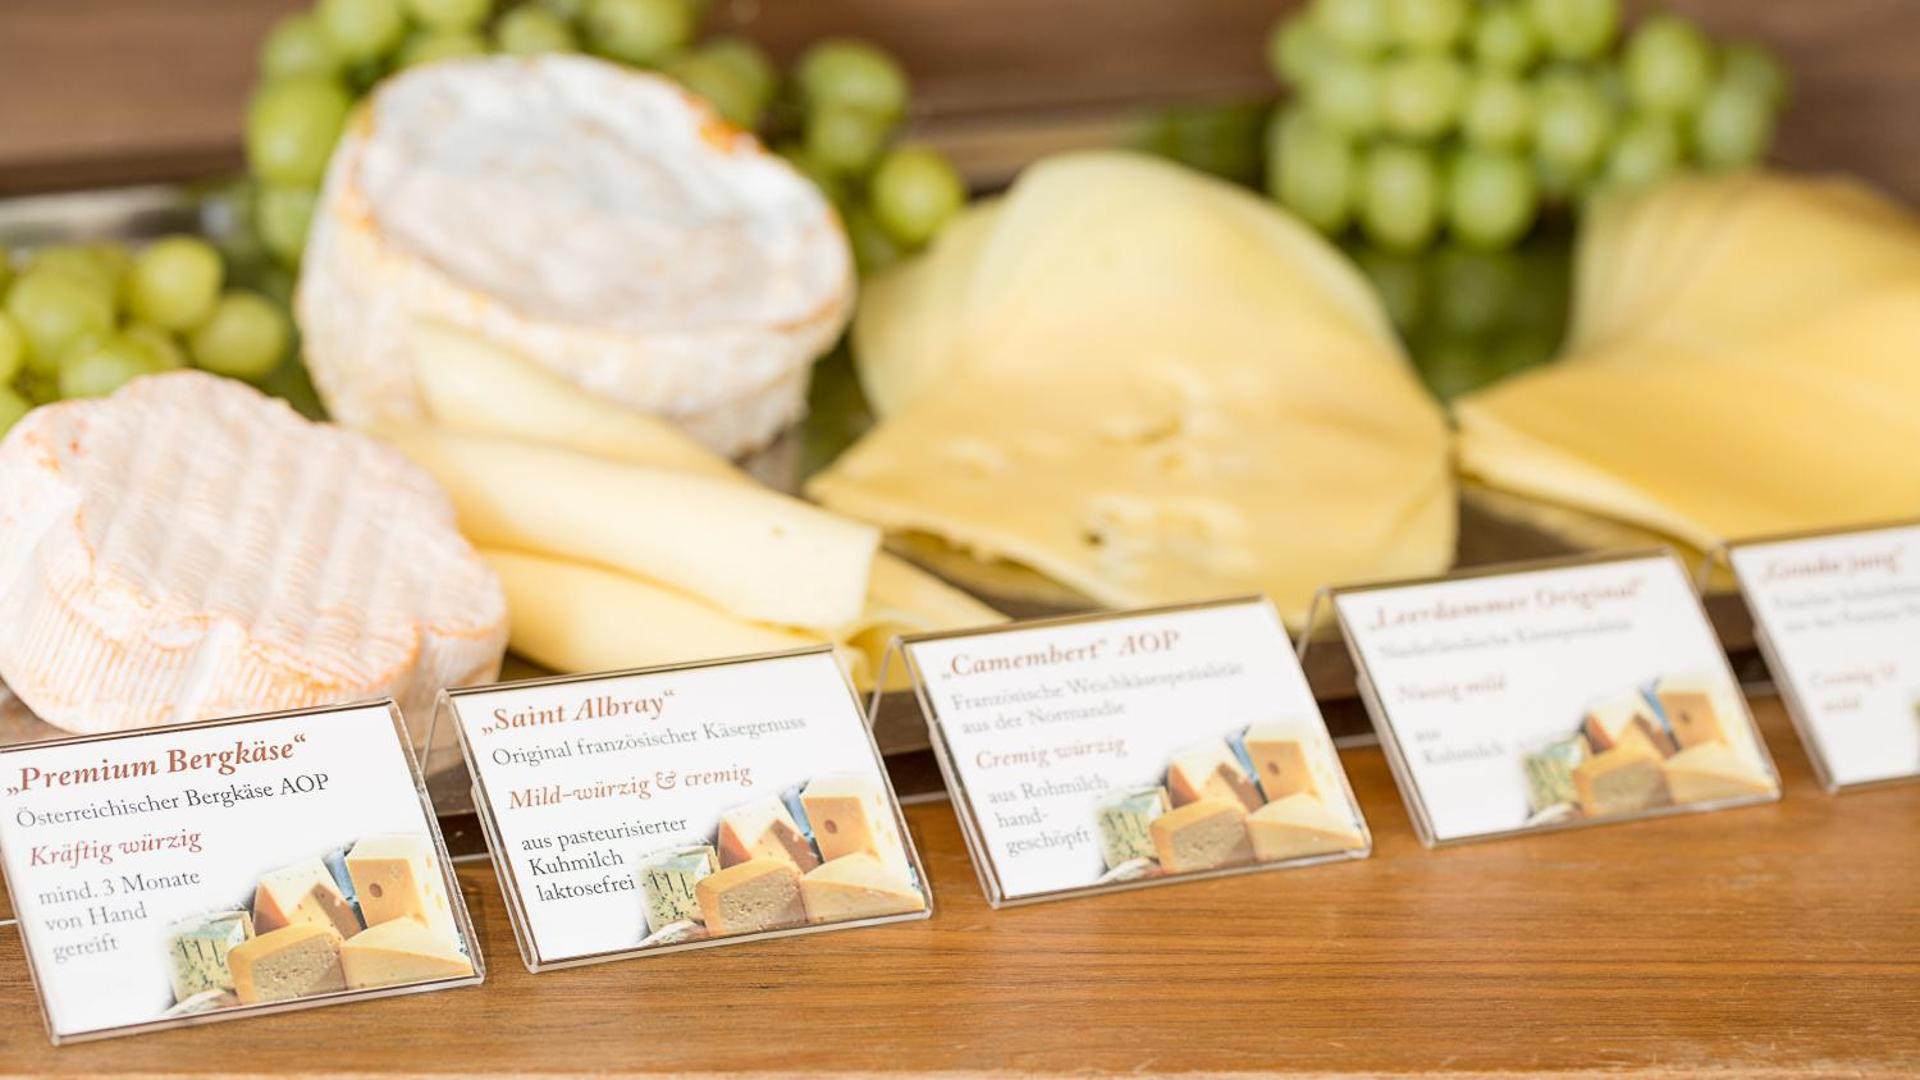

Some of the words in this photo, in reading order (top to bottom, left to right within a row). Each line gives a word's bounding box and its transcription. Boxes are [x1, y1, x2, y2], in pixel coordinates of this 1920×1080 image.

[942, 639, 1108, 680] „Camembert“
[1117, 630, 1180, 657] AOP
[481, 703, 566, 736] „Saint
[574, 689, 675, 721] Albray“
[950, 685, 1064, 711] Französische
[962, 720, 990, 735] aus
[995, 708, 1023, 731] der
[1027, 700, 1126, 726] Normandie
[491, 742, 573, 768] Original
[576, 725, 698, 756] französischer
[703, 716, 808, 743] Käsegenuss
[975, 743, 1051, 768] Cremig
[1053, 738, 1130, 759] würzig
[5, 757, 160, 797] „Premium
[167, 733, 307, 776] Bergkäse“
[16, 794, 181, 828] Österreichischer
[185, 783, 275, 808] Bergkäse
[279, 772, 330, 797] AOP
[508, 775, 653, 811] Mild-würzig
[655, 770, 678, 790] &
[684, 765, 754, 788] cremig
[988, 789, 1018, 804] aus
[1020, 773, 1110, 799] Rohmilch
[521, 835, 553, 852] aus
[556, 817, 688, 851] pasteurisierter
[995, 807, 1049, 829] hand-
[29, 839, 114, 869] Kräftig
[118, 828, 203, 853] würzig
[1005, 825, 1091, 858] geschöpft
[528, 849, 625, 877] Kuhmilch
[38, 880, 99, 906] mind.
[103, 877, 116, 897] 3
[121, 869, 202, 896] Monate
[535, 873, 637, 903] laktosefrei
[45, 916, 83, 933] von
[88, 900, 149, 927] Hand
[52, 932, 119, 964] gereift
